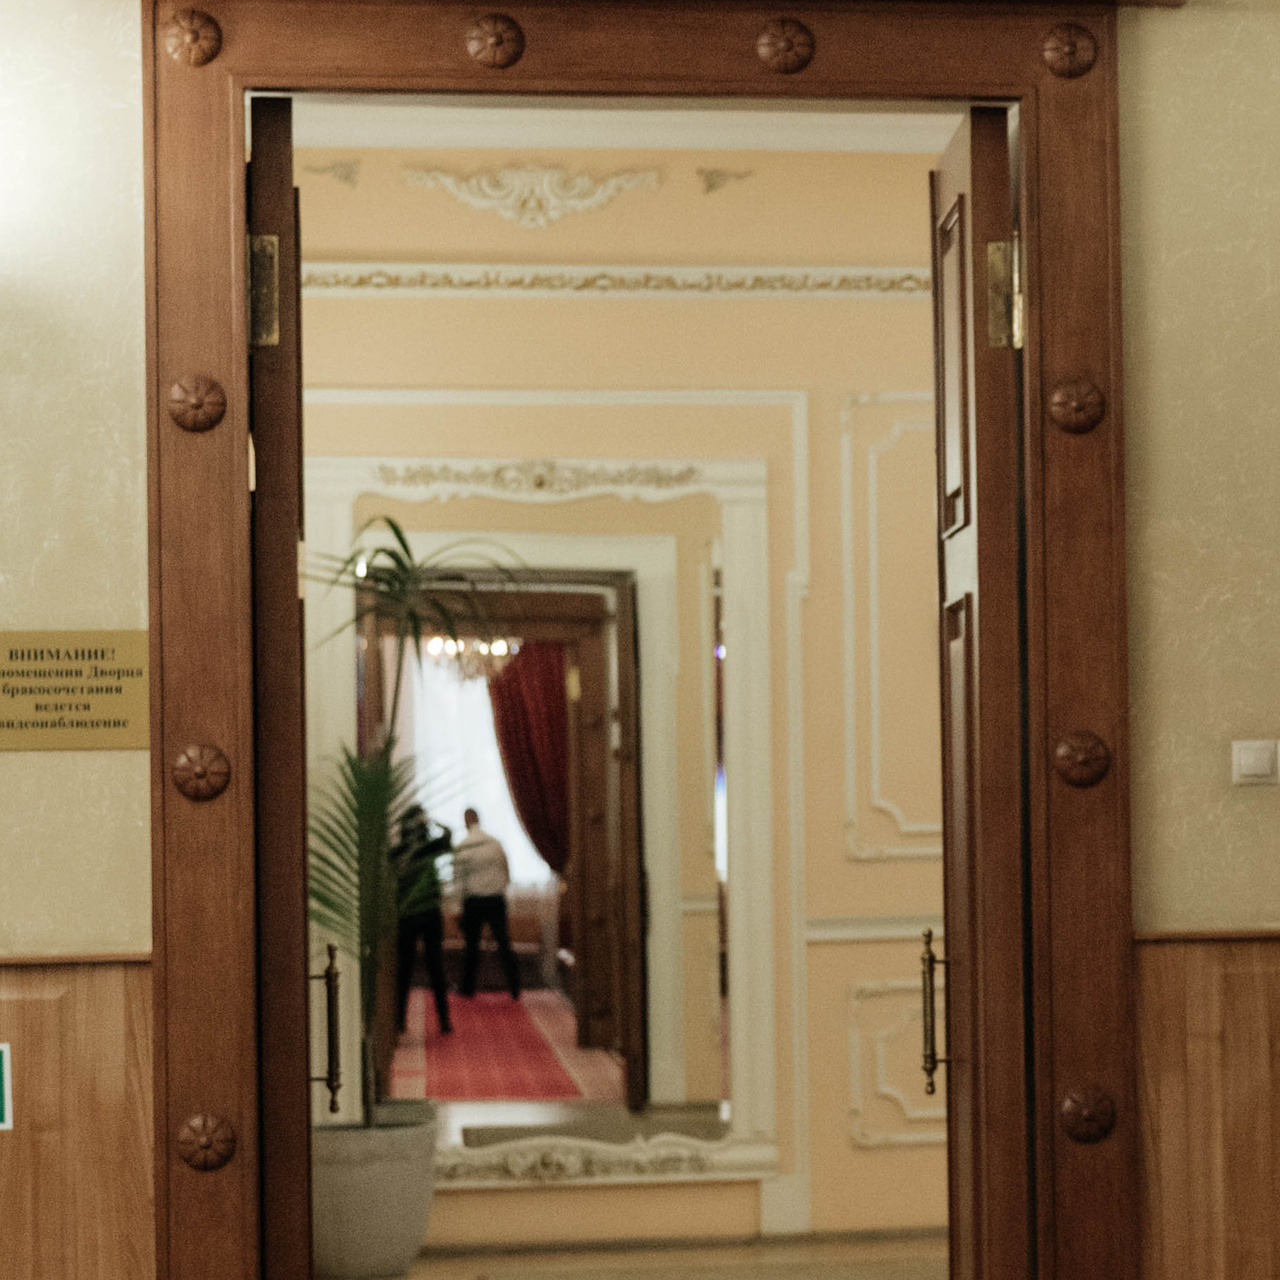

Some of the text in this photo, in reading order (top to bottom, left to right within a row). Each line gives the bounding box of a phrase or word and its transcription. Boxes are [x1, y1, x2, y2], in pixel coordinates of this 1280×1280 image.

[9, 648, 115, 661] ВНИМАНИЕ!
[86, 666, 143, 680] Дворца
[2, 683, 122, 698] бракосочетания
